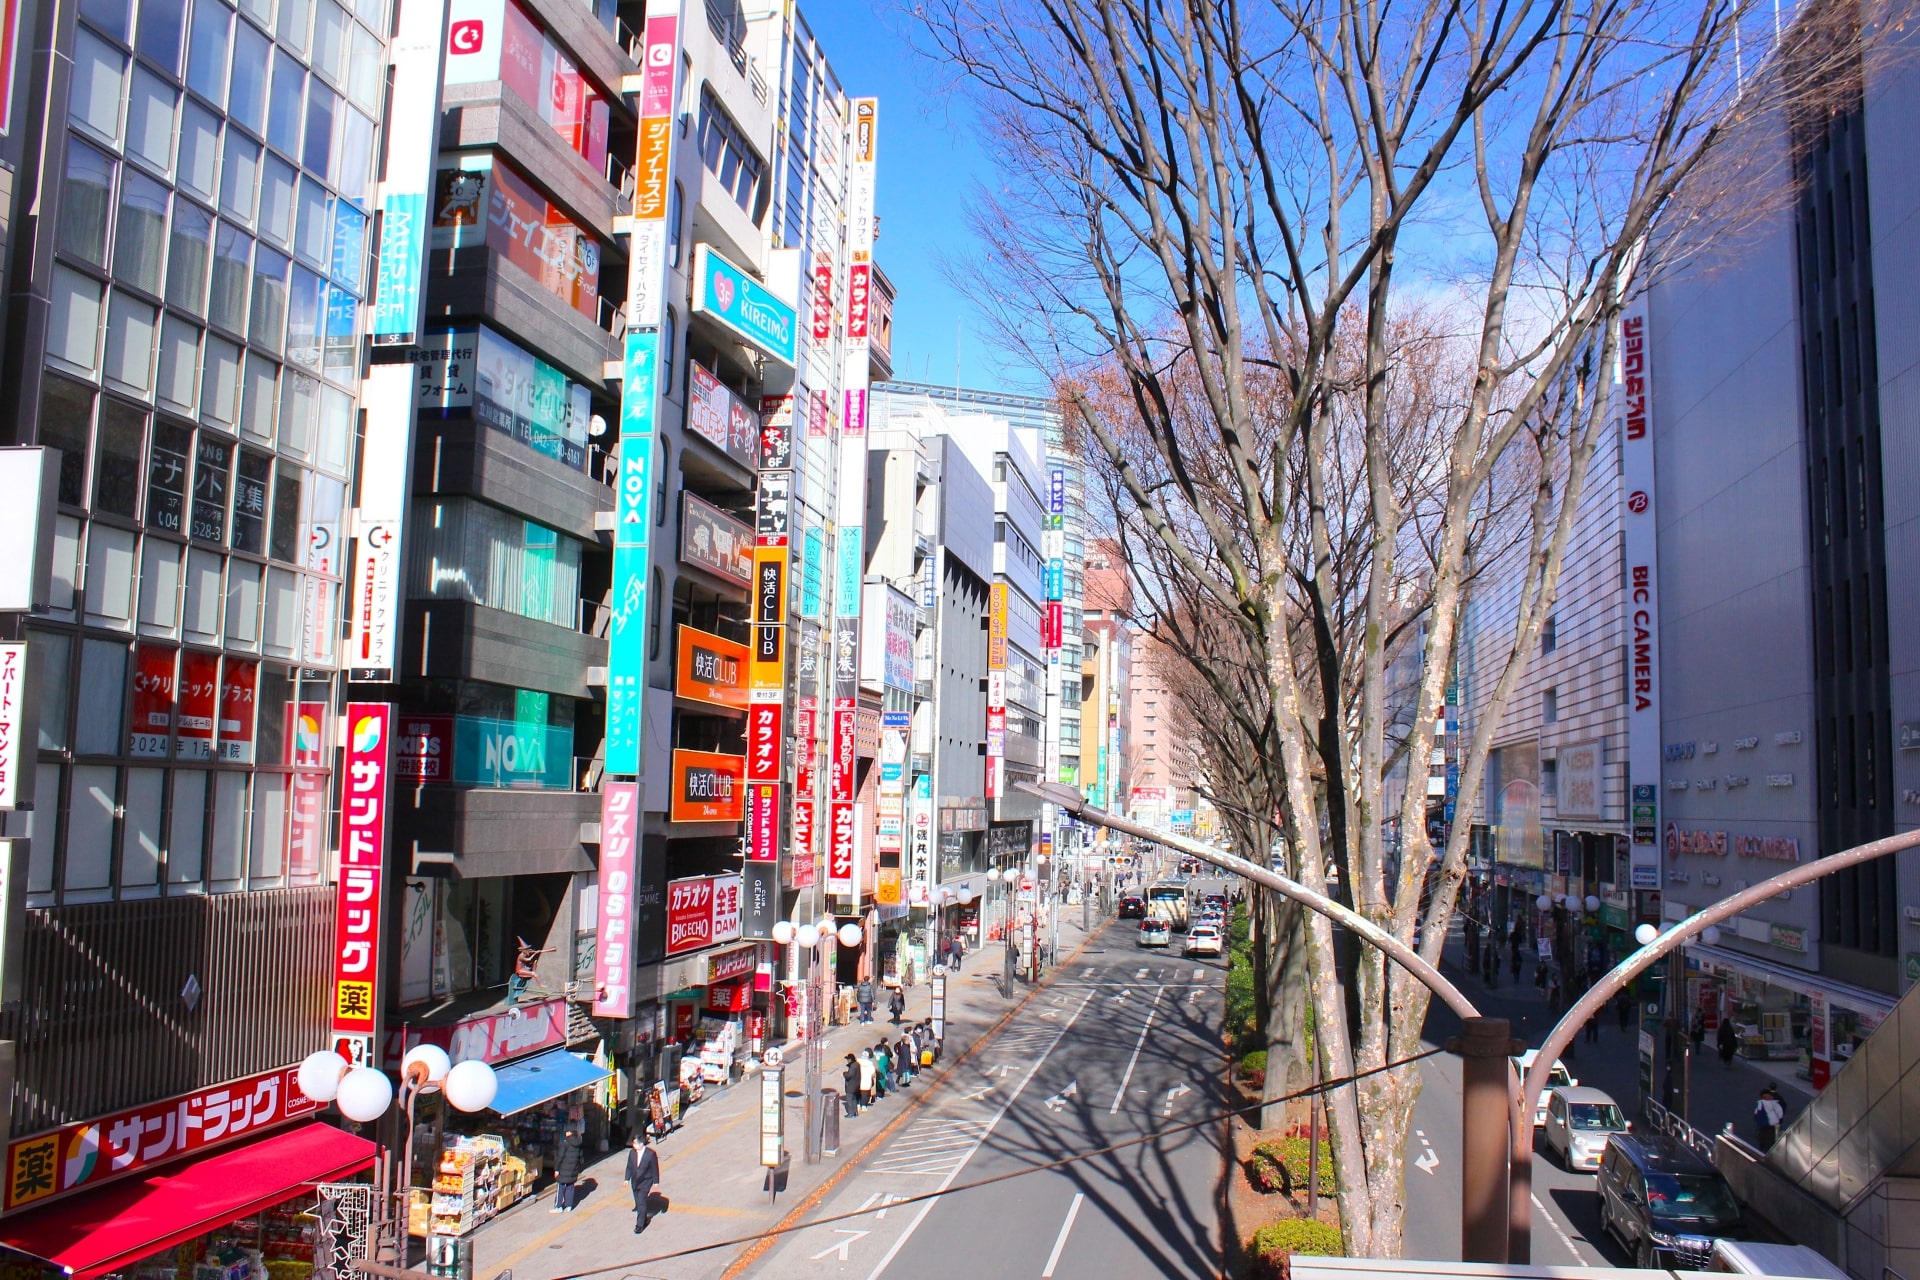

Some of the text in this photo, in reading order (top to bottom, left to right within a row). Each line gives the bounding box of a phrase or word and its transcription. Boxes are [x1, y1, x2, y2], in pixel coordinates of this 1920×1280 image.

[642, 122, 670, 214] ジェイエステ
[390, 212, 413, 316] MUSEE
[718, 282, 731, 305] 3F
[851, 273, 868, 333] カラオケ
[740, 299, 789, 345] KIREIMO
[409, 348, 473, 363] 社宅管理代行
[1624, 315, 1646, 441] ビックカメラ
[767, 457, 783, 468] 6F
[623, 456, 643, 524] NOVA
[767, 536, 780, 546] 5F
[373, 551, 389, 665] クリニックプラス
[762, 567, 777, 655] 快活CLUB
[1633, 565, 1652, 712] BIC CAMERA
[364, 669, 376, 679] 3F
[695, 651, 737, 686] 快活CLUB
[150, 674, 253, 703] クリニックプラス
[989, 715, 1003, 730] 薬
[397, 736, 441, 755] KIDS
[485, 733, 547, 774] NOVA
[755, 709, 774, 774] カラオケ
[689, 770, 732, 798] 快活CLUB
[837, 791, 848, 800] 2F
[760, 798, 772, 859] サンドラッグ
[834, 806, 852, 875] カラオケ
[1635, 829, 1654, 838] Seria
[341, 760, 381, 974] サンドラッグ
[915, 829, 928, 882] 磯丸水産
[599, 790, 633, 1008] クスリ OSドラッグ
[671, 883, 711, 912] カラオケ
[715, 885, 738, 917] 全室
[753, 879, 762, 917] GEMME
[671, 919, 709, 945] BIG ECHO
[715, 917, 737, 935] DAM
[934, 966, 944, 974] 15
[340, 984, 371, 1017] 薬
[712, 987, 731, 1007] 薬
[765, 1051, 779, 1063] 14
[16, 1076, 281, 1200] 薬 サンドラッグ
